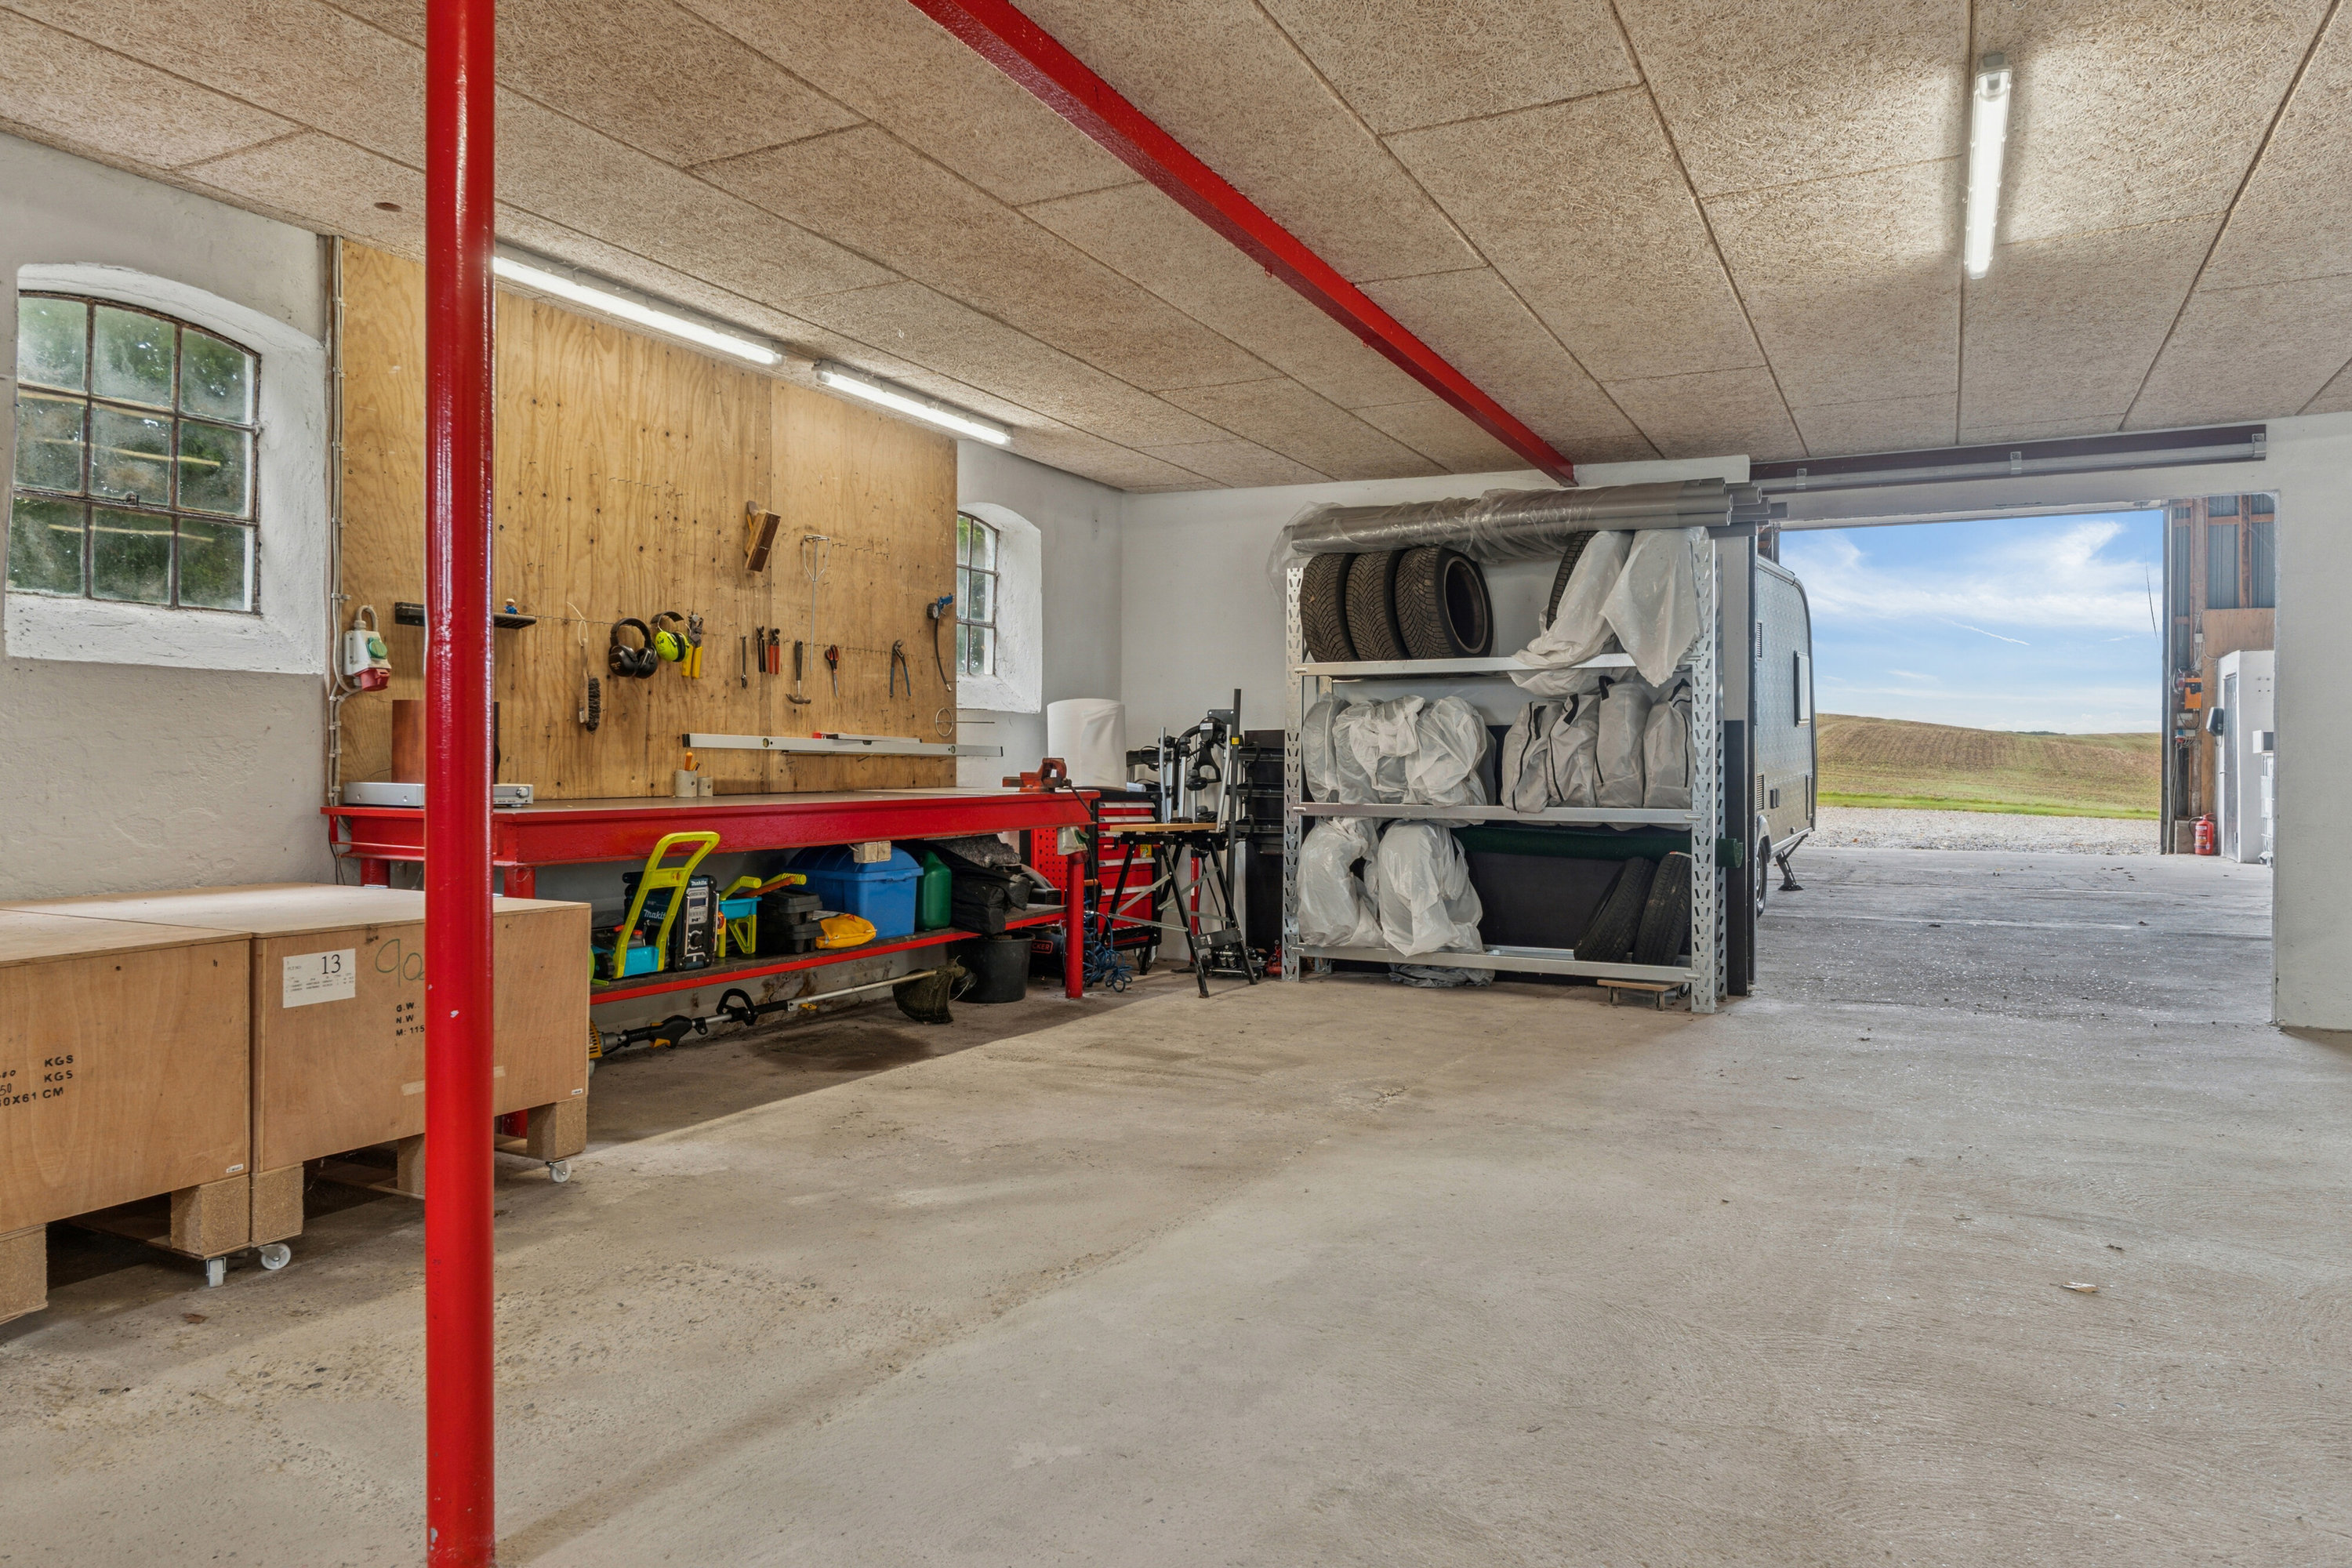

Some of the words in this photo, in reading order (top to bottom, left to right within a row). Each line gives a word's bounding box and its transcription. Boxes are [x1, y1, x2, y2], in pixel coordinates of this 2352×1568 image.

[321, 953, 340, 975] 13
[45, 1054, 74, 1067] KGS
[44, 1069, 73, 1083] KGS
[0, 1091, 36, 1107] 0X61
[42, 1087, 64, 1098] CM
